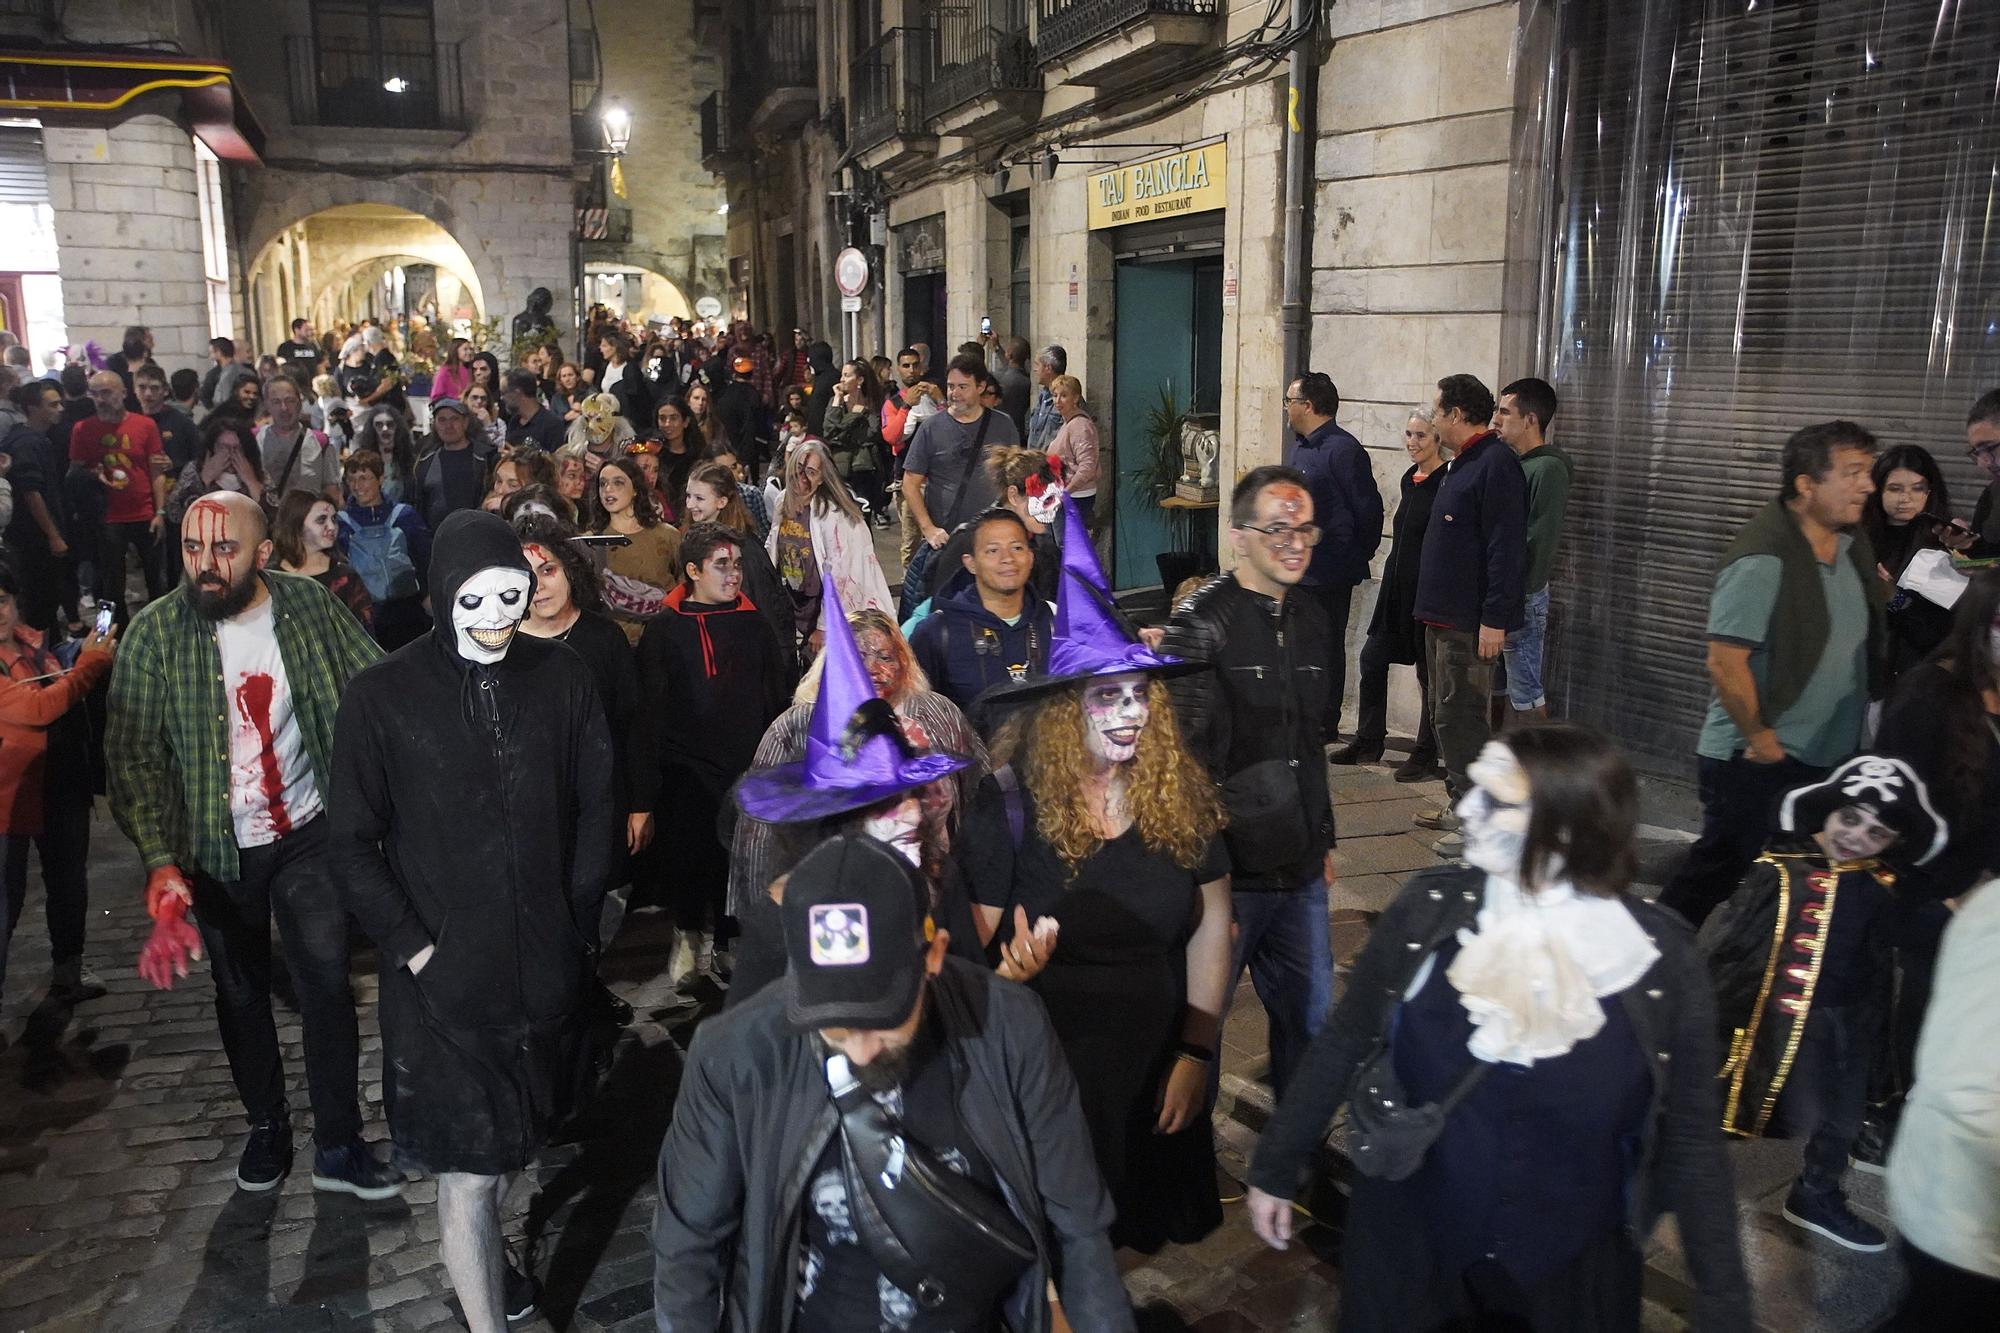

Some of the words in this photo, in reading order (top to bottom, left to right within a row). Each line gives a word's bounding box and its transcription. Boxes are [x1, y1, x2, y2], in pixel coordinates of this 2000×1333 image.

[1099, 171, 1125, 207] TAJ
[1134, 150, 1209, 200] BANGLA
[1111, 209, 1130, 222] INDIAN
[1135, 205, 1150, 218] FOOD
[1154, 196, 1192, 214] RESTAURANT
